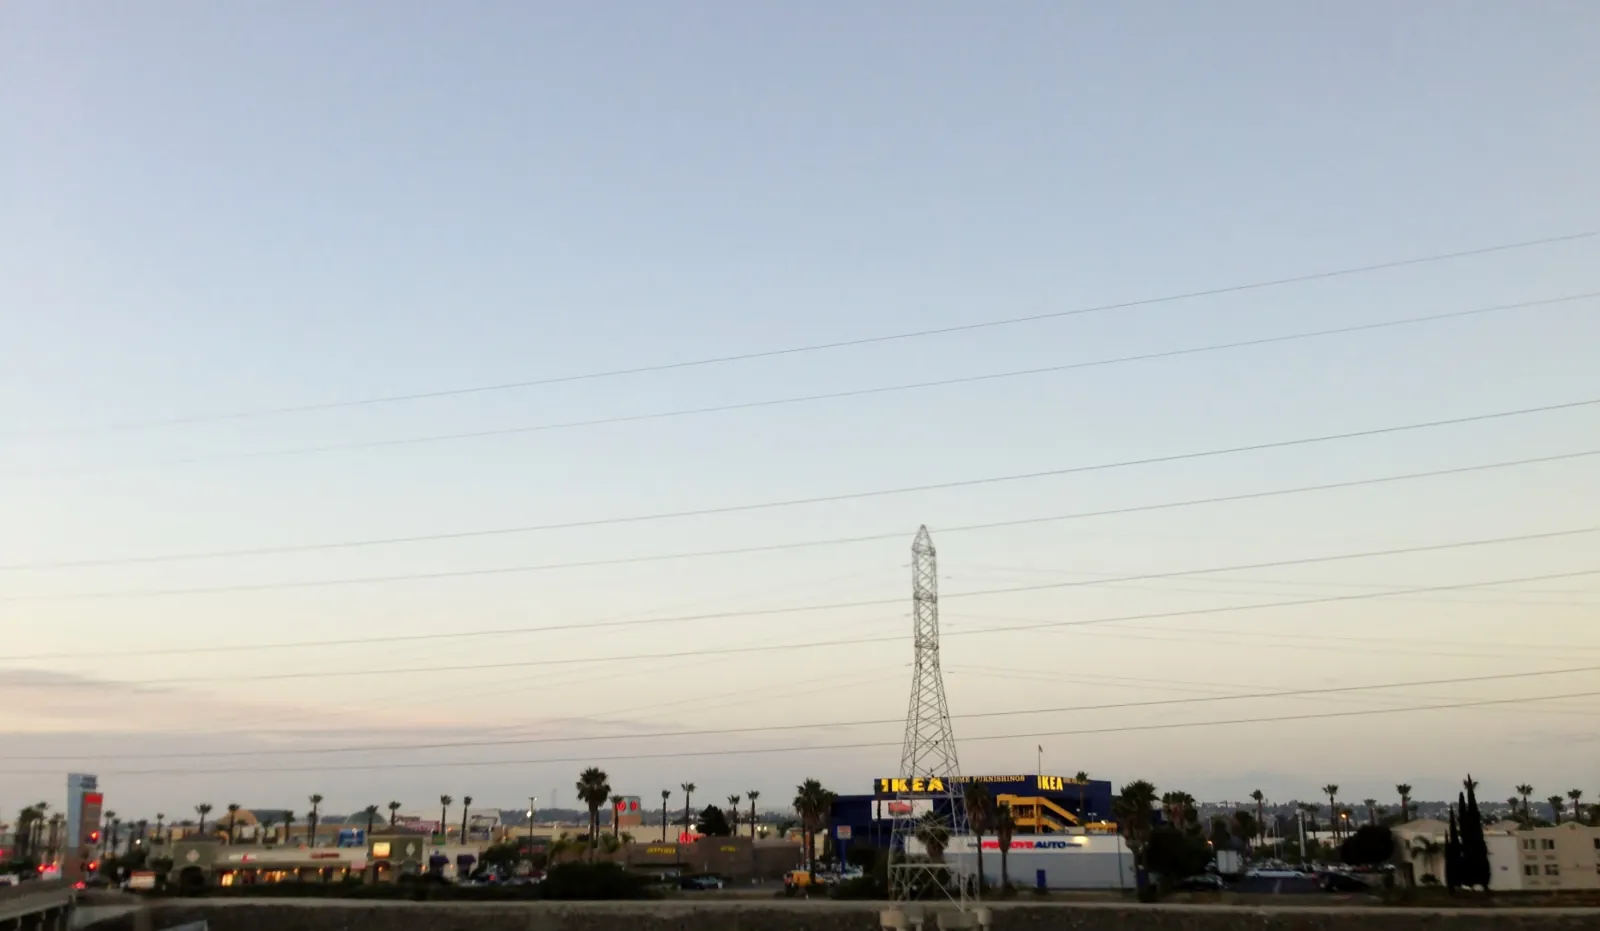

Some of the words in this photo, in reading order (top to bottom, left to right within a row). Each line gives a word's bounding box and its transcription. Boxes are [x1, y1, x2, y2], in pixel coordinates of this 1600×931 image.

[880, 777, 944, 793] IKEA
[973, 774, 1025, 783] FURNISHINGS
[1037, 775, 1064, 791] IKEA
[1036, 840, 1067, 849] AUTO
